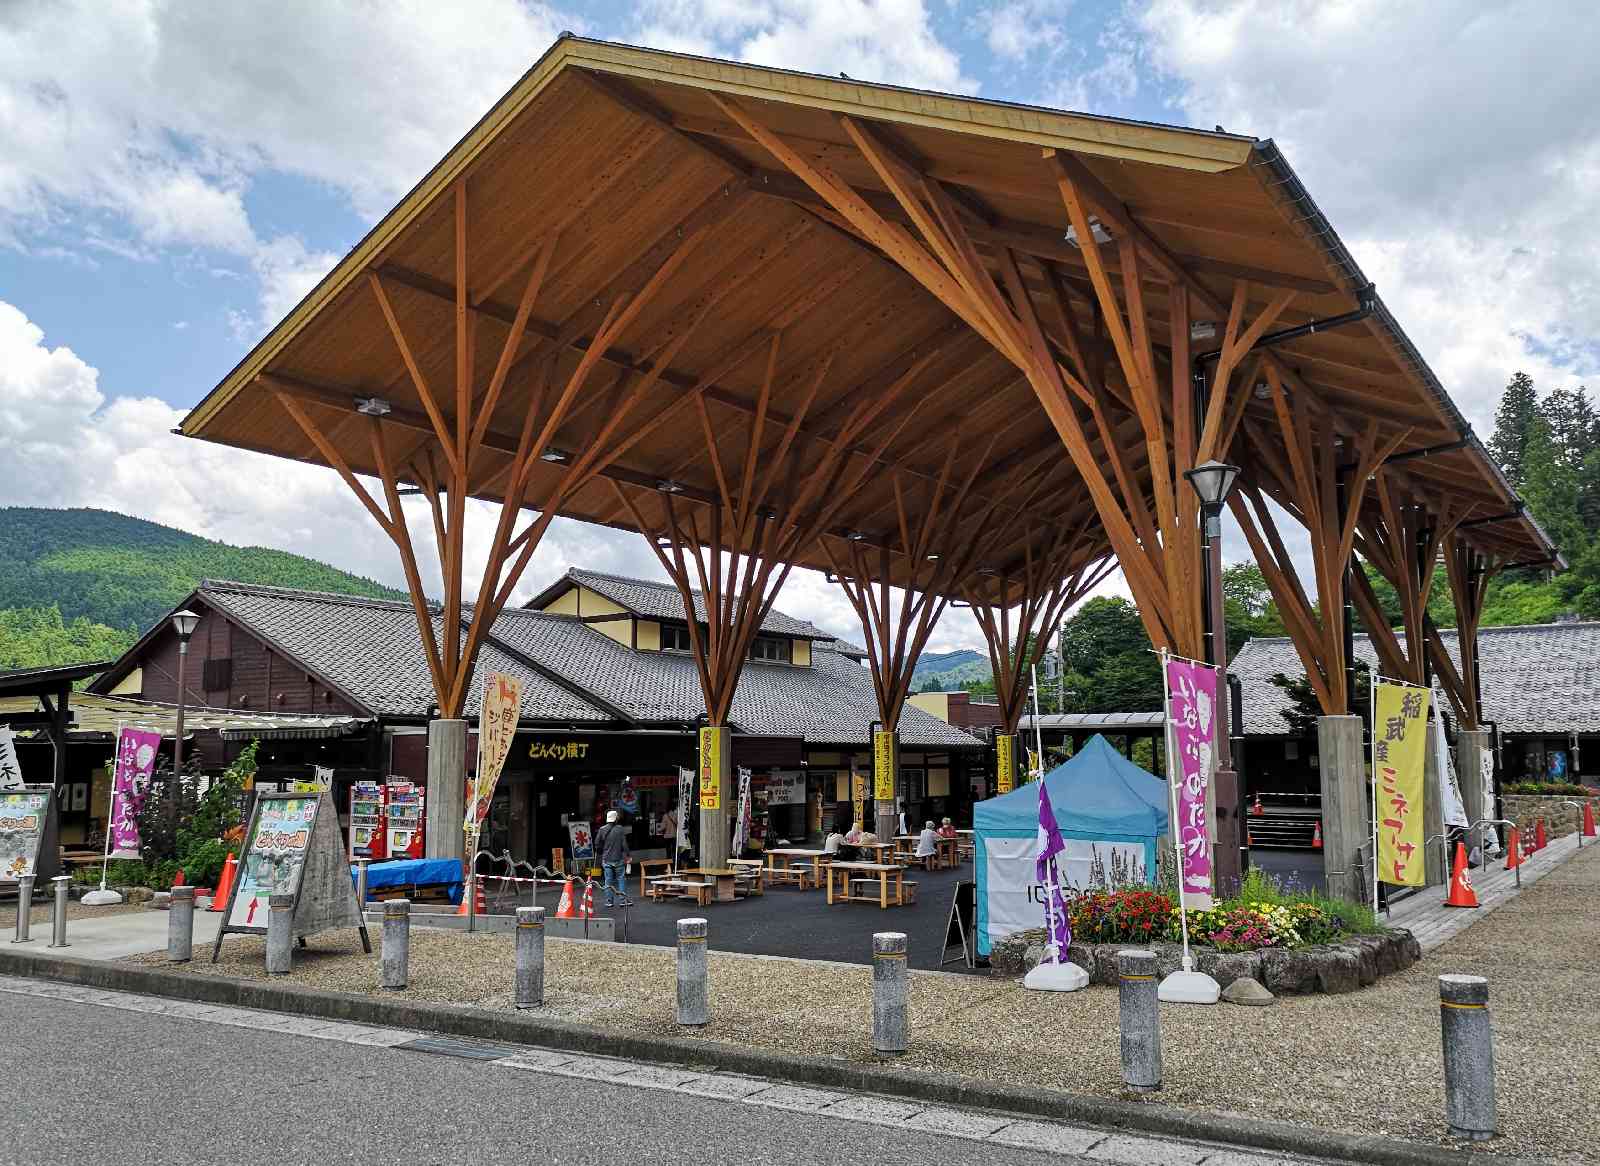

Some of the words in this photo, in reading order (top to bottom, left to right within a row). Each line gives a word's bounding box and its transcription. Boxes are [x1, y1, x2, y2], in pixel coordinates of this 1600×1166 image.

[528, 742, 589, 761] どんぐり横丁
